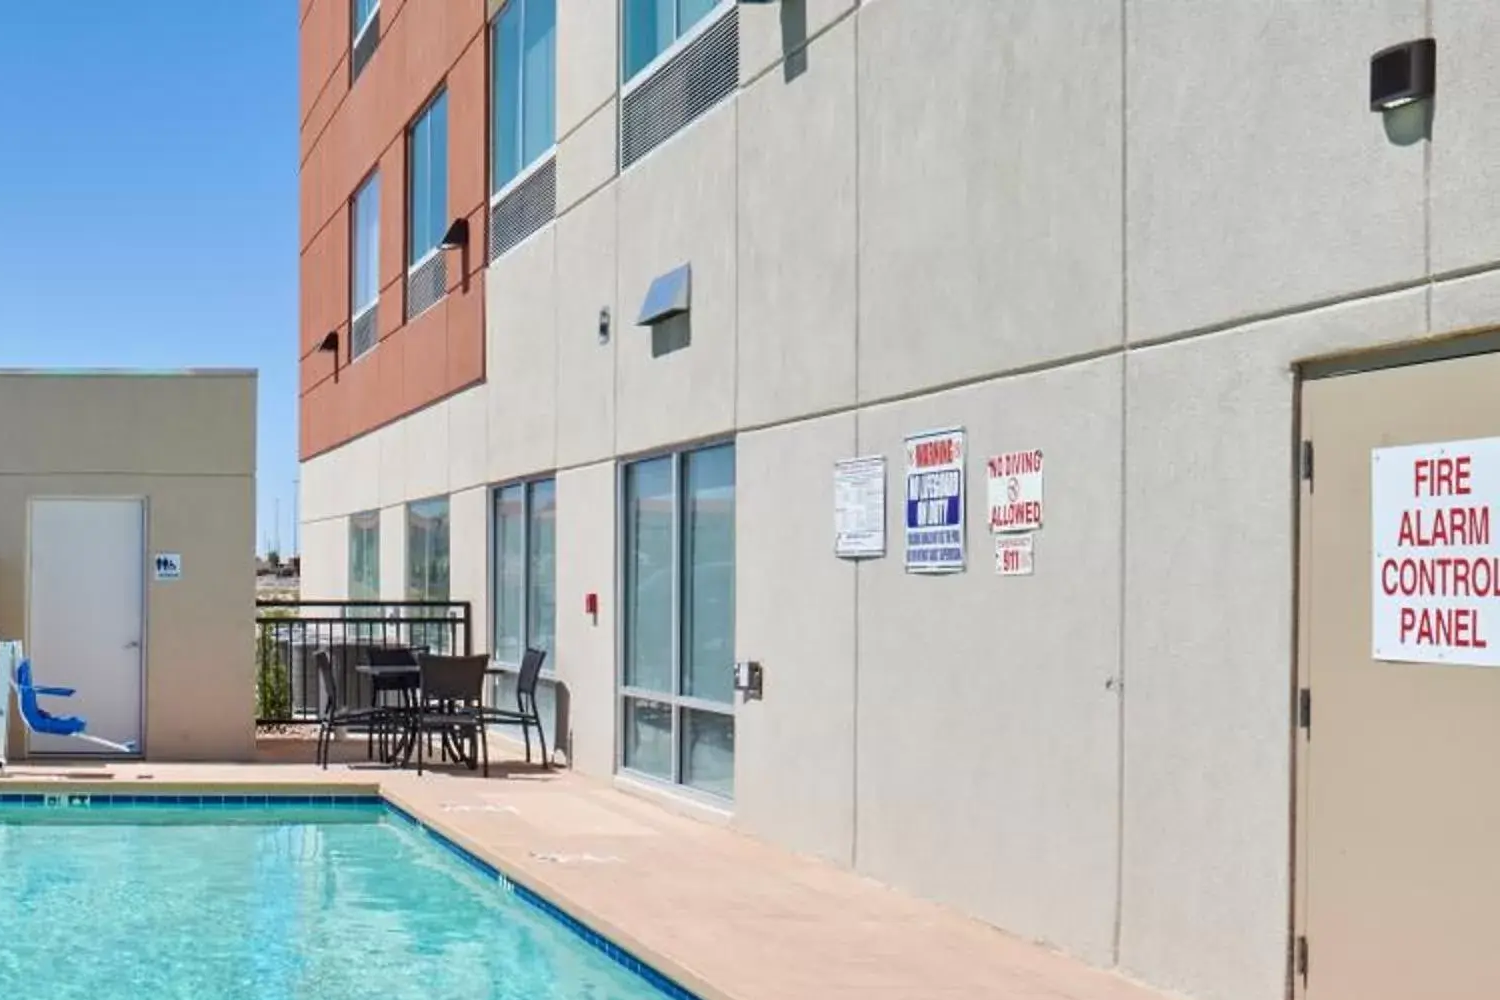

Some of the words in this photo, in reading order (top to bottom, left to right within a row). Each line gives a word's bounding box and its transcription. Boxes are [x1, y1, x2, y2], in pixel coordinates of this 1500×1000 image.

[988, 457, 1003, 478] NO
[1005, 450, 1043, 476] DIVING
[1414, 456, 1471, 497] FIRE
[991, 501, 1041, 526] ALLOWED
[1397, 506, 1490, 546] ALARM
[1003, 550, 1019, 571] 911
[1381, 557, 1500, 597] CONTROL
[1400, 607, 1487, 648] PANEL
